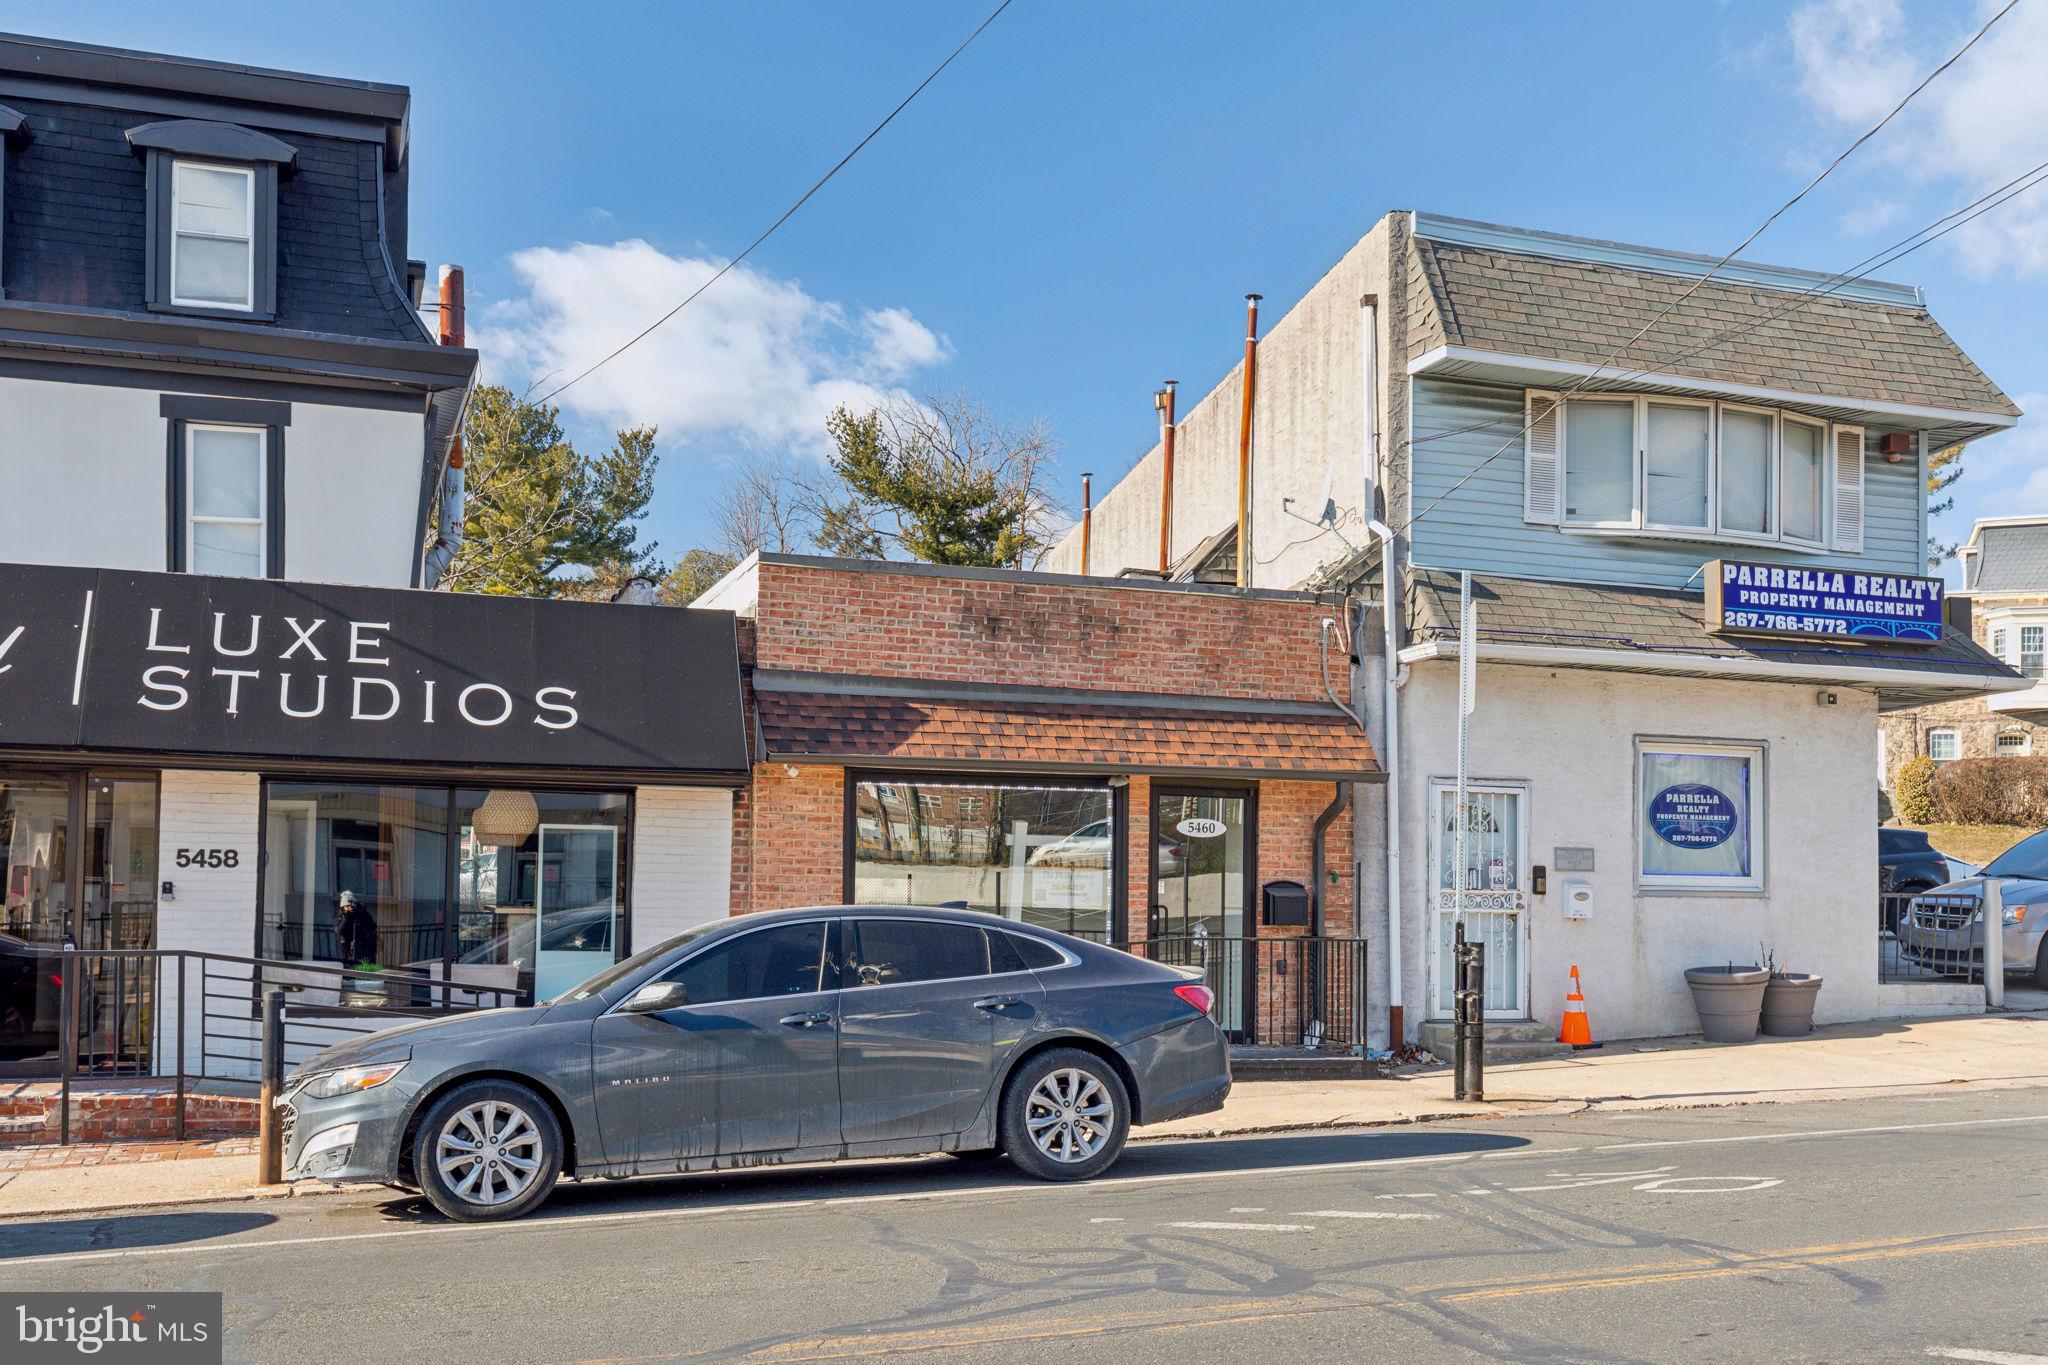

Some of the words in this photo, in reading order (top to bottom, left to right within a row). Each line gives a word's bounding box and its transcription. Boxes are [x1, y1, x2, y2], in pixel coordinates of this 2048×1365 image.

[1723, 564, 1845, 594] PARRELLA
[1854, 575, 1941, 600] REALTY
[1740, 591, 1818, 609] PROPERTY
[1824, 597, 1925, 617] MANAGEMENT
[1725, 611, 1847, 634] 267-766-5772
[145, 607, 390, 666] LUXE
[137, 665, 579, 729] STUDIOS
[1666, 793, 1720, 804] PARRELLA
[1677, 804, 1710, 813] REALTY
[1187, 821, 1216, 834] 5460
[1672, 834, 1718, 842] 267-766-5772
[176, 848, 239, 869] 5458
[612, 1075, 670, 1086] MALIBU
